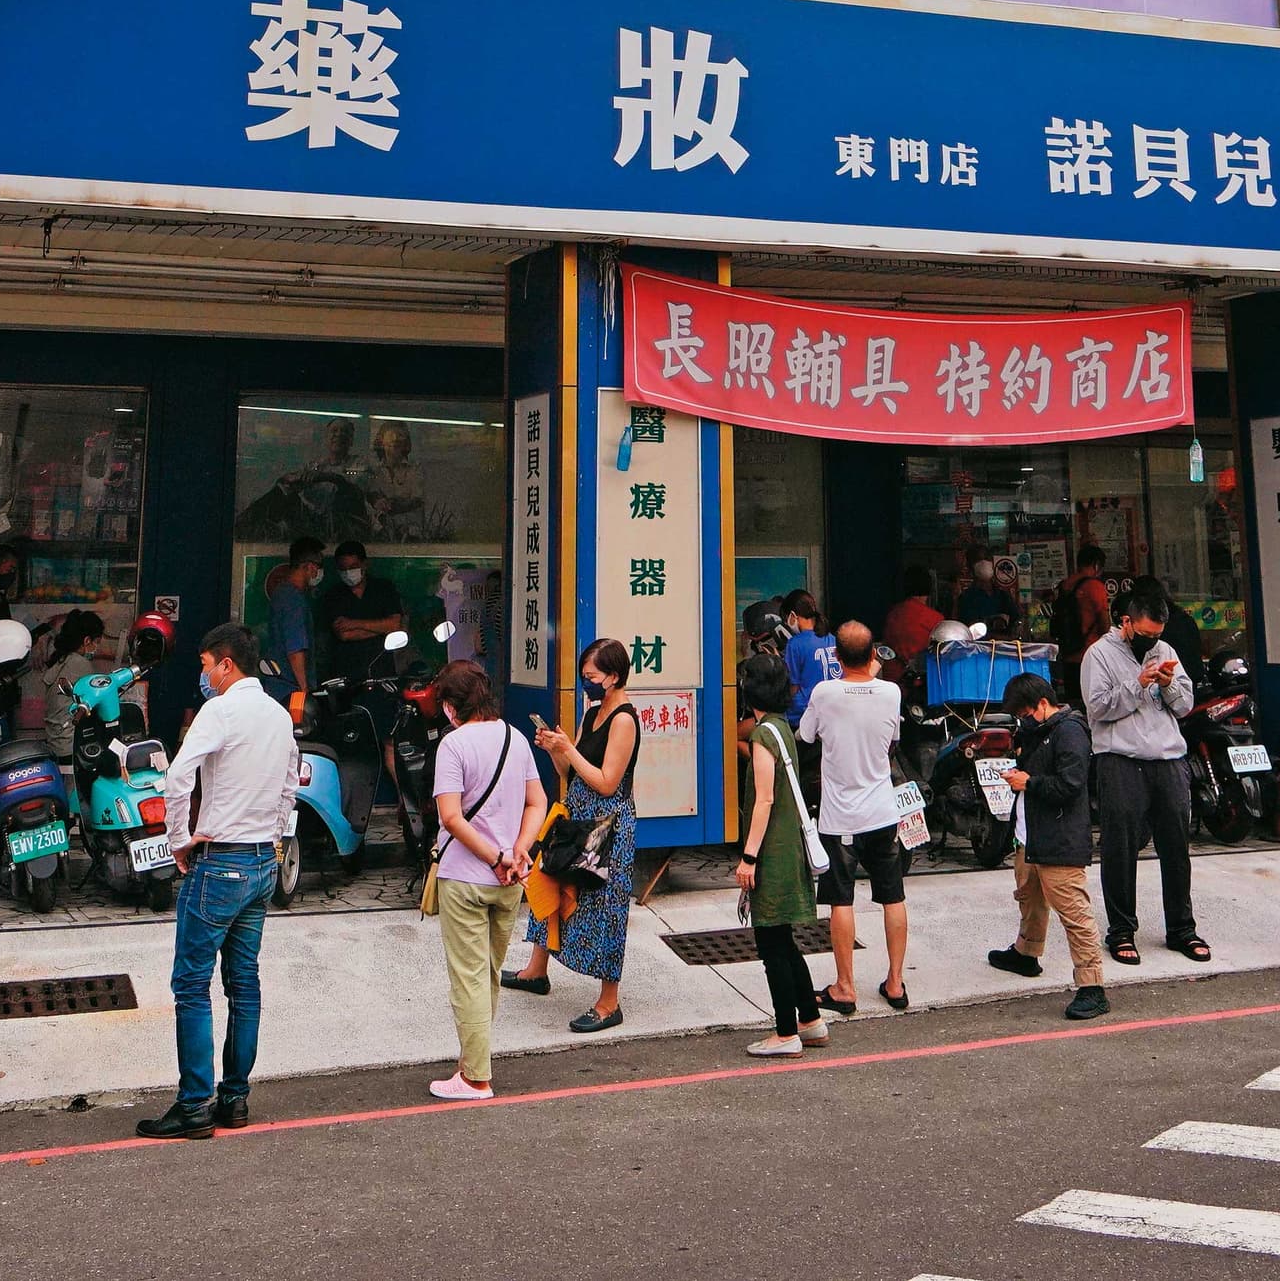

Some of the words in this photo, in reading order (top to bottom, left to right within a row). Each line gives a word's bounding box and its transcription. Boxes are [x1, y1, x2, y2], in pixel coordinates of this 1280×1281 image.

[833, 133, 979, 187] 東門店
[654, 299, 910, 415] 長照輔具
[934, 330, 1175, 417] 特約商店
[524, 409, 542, 672] 諾貝兒成長奶粉
[629, 405, 667, 675] 醫療器材
